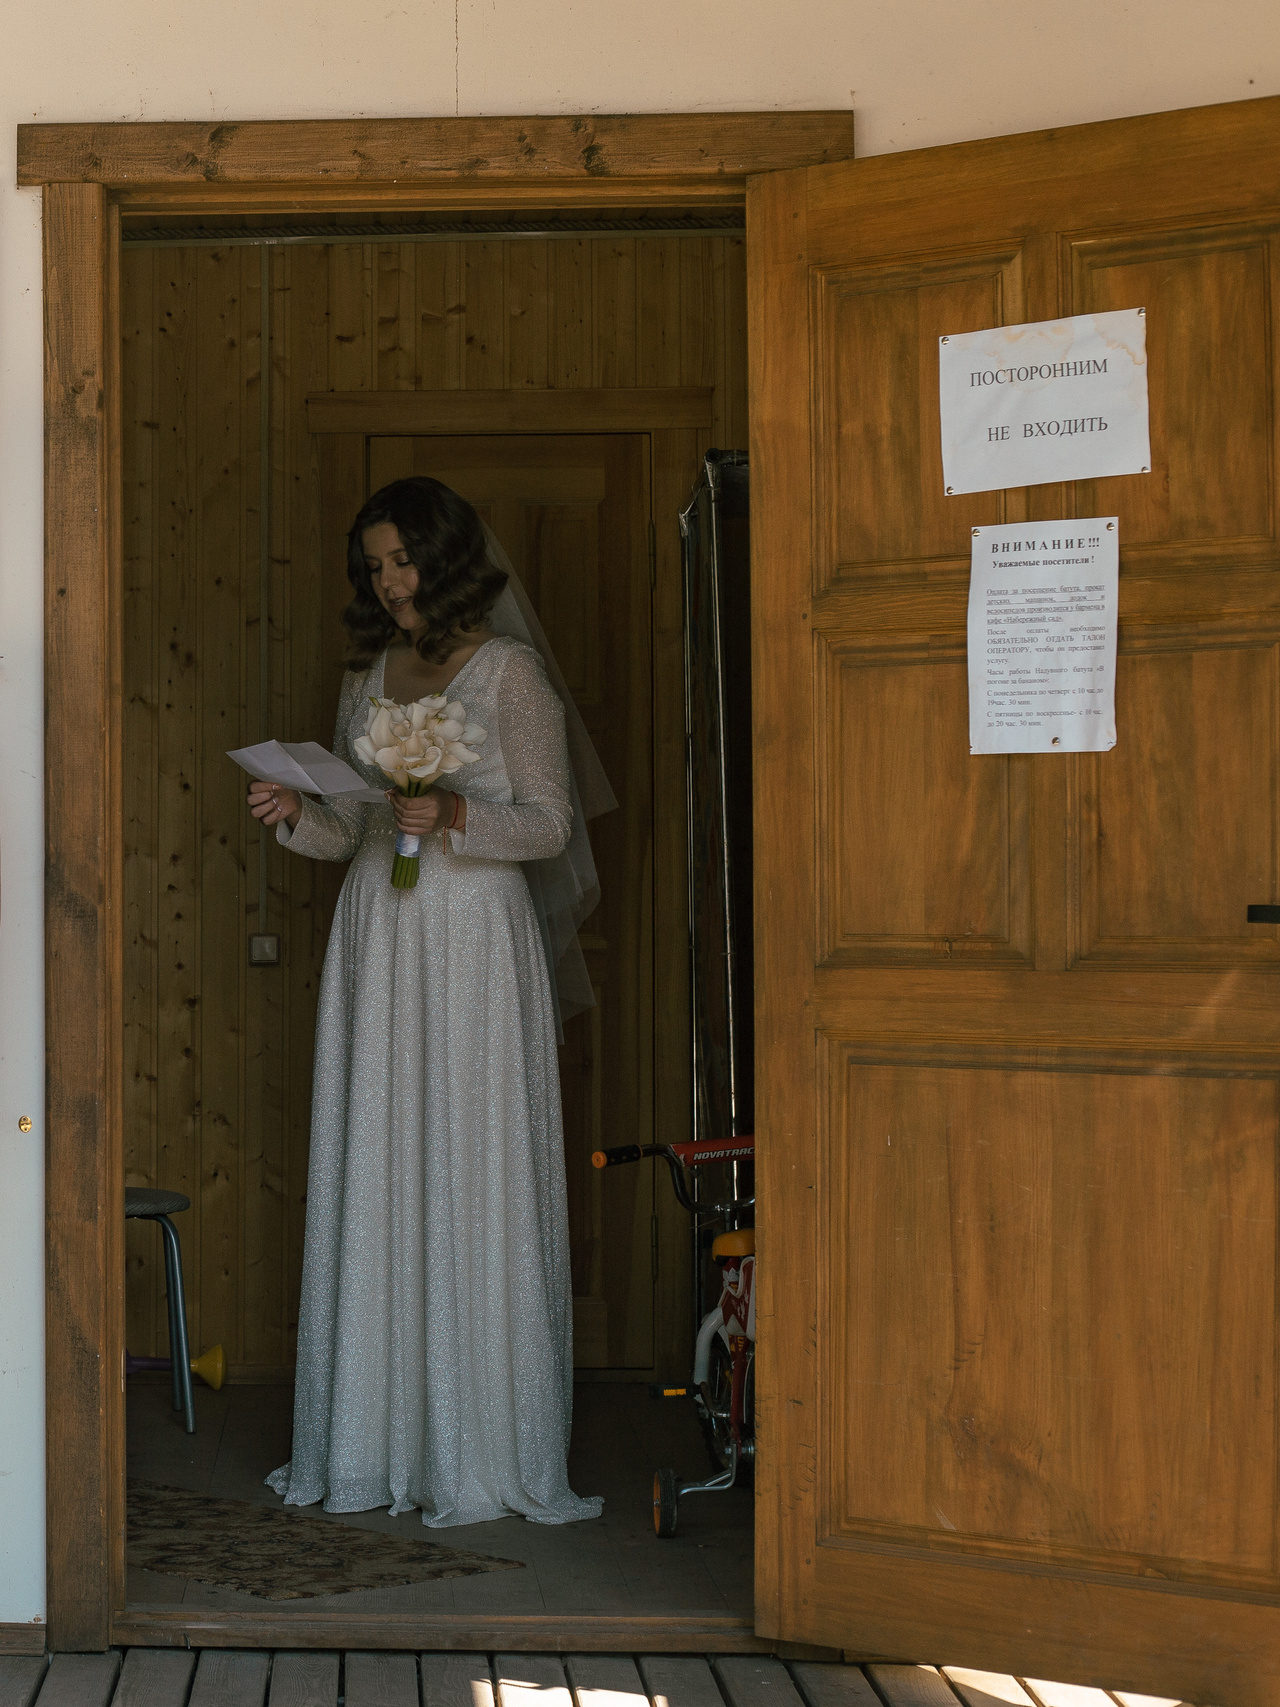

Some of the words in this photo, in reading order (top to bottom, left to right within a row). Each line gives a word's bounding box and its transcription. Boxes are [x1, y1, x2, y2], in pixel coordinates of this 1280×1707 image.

[970, 358, 1108, 387] ПОСТОРОННИМ
[987, 426, 1010, 441] НЕ
[1023, 417, 1108, 438] ВХОДИТЬ
[992, 558, 1040, 568] Уважаемые
[1045, 635, 1075, 643] ОТДАТЬ
